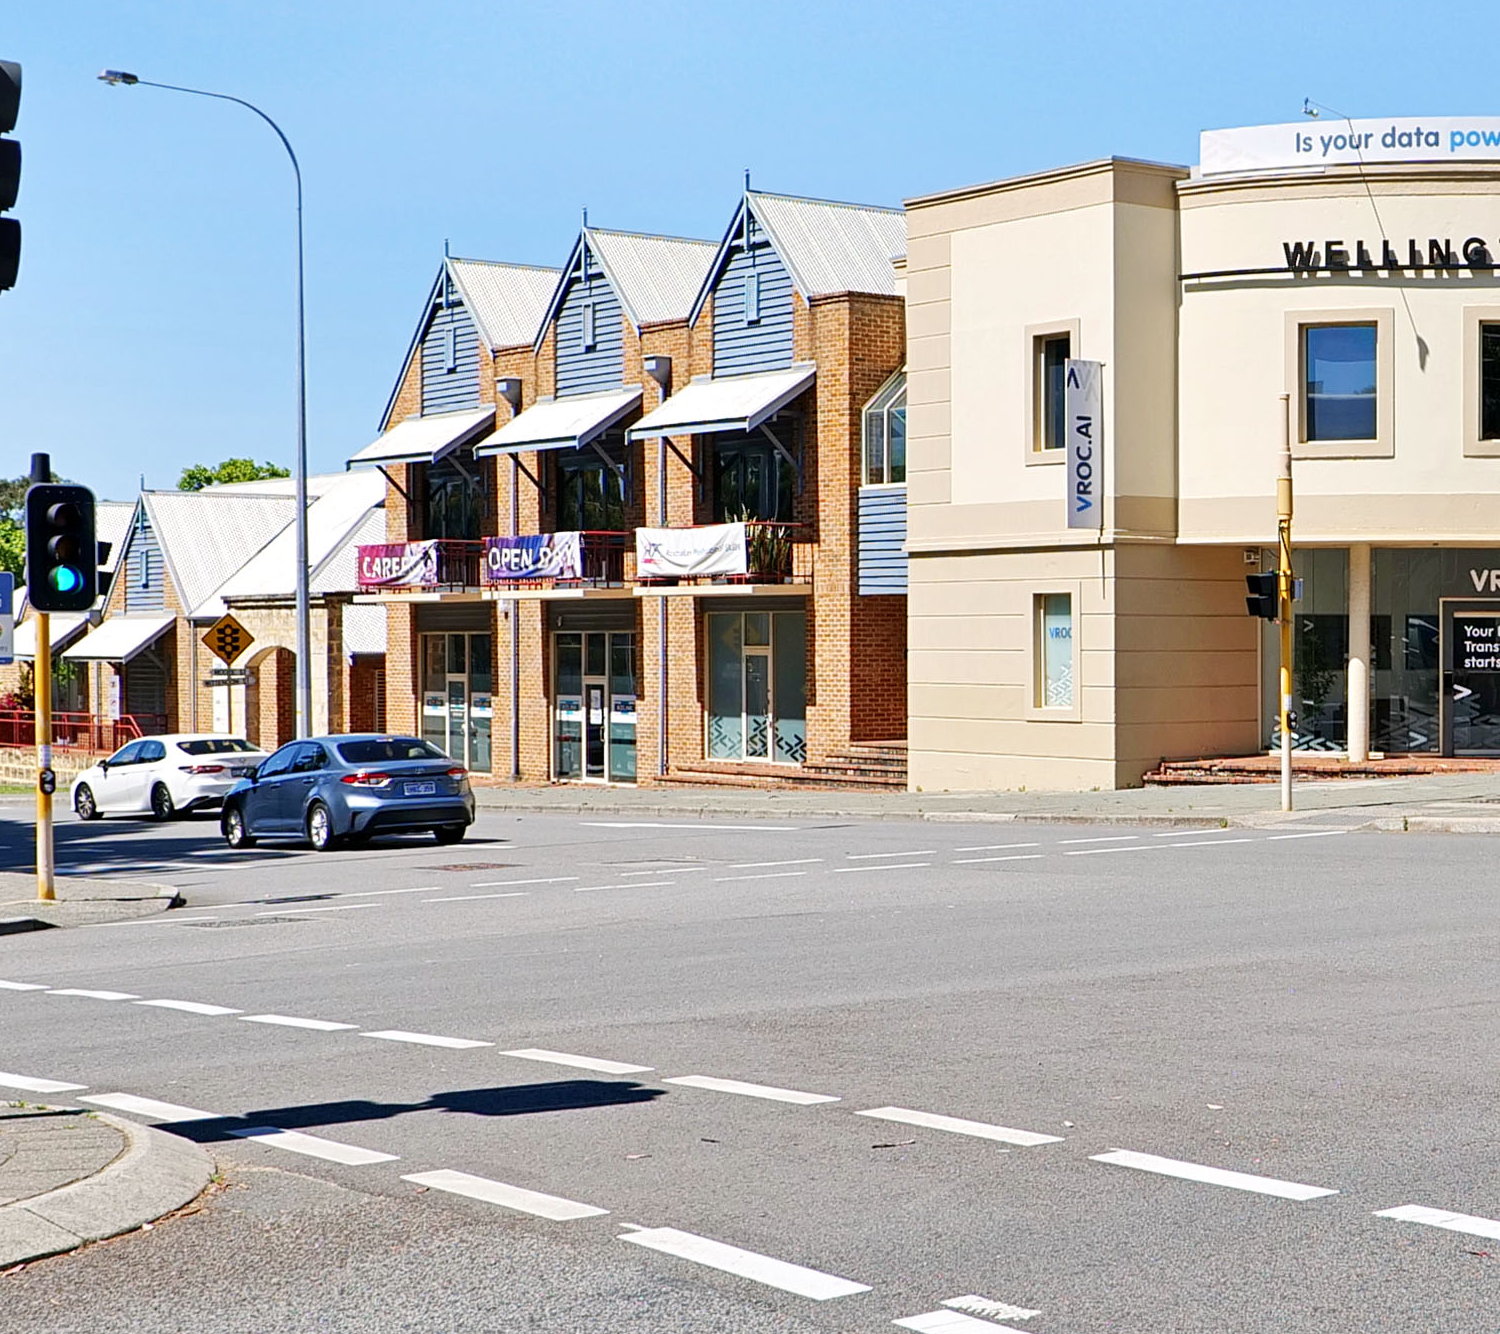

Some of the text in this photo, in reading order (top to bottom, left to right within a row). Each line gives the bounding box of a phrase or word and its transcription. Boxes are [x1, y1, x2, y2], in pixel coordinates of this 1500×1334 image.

[1295, 131, 1313, 154] Is
[1319, 129, 1374, 157] your
[1381, 125, 1440, 149] data
[1076, 415, 1093, 513] VROC.AI
[488, 546, 533, 569] OPEN
[1464, 625, 1494, 637] Your
